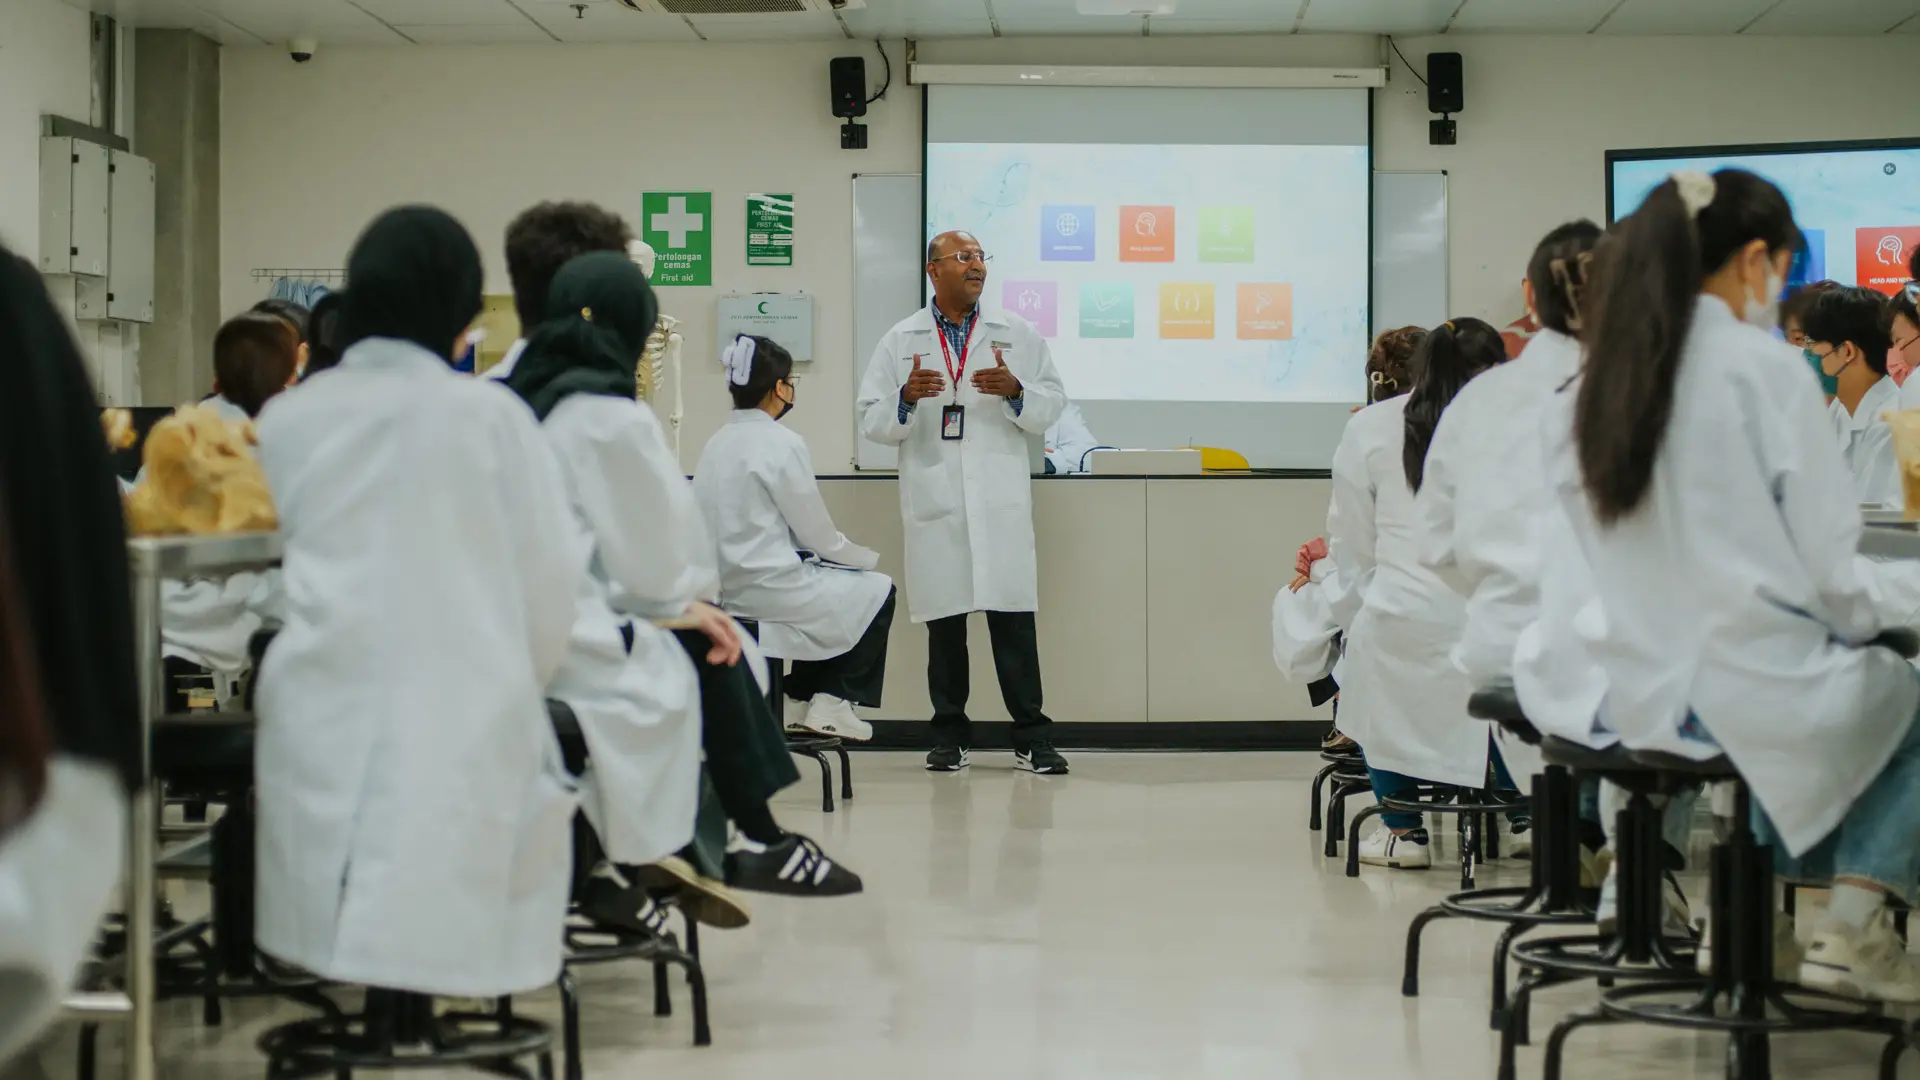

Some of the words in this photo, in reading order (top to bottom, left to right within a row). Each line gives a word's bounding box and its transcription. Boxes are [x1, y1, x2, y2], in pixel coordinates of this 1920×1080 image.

[653, 253, 702, 262] Pertolongan
[660, 274, 679, 282] First
[681, 274, 694, 282] aid
